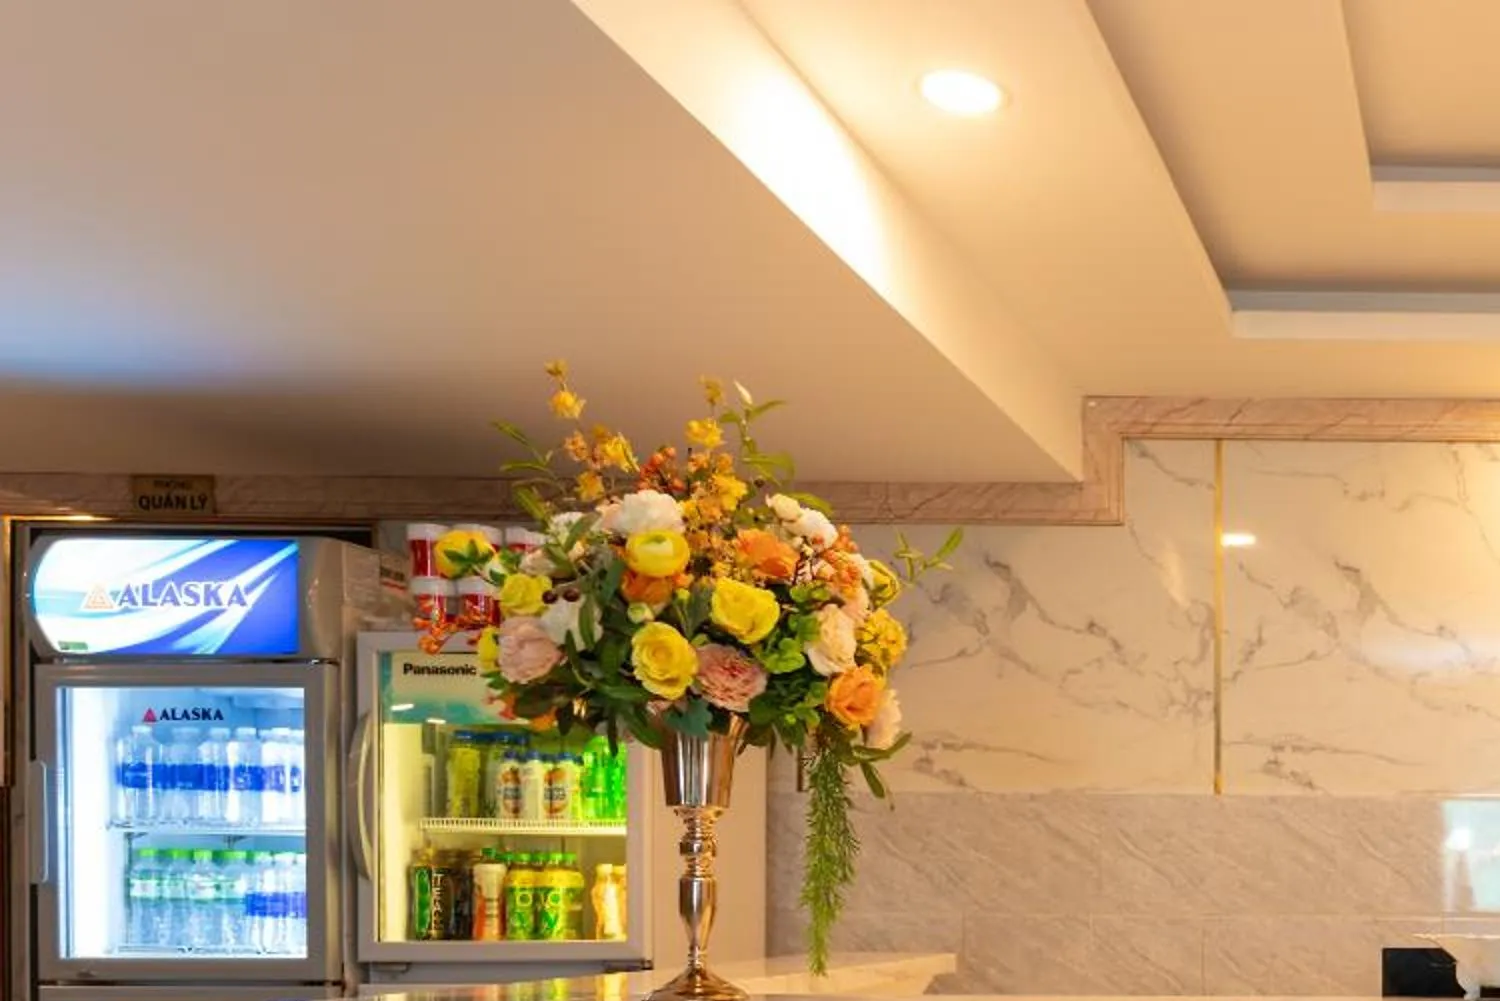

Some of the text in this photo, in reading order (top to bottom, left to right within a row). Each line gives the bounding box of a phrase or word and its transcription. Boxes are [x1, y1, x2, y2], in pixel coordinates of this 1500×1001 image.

[118, 581, 248, 607] ALASKA
[403, 663, 477, 675] Panasonic
[159, 708, 224, 721] ALASKA
